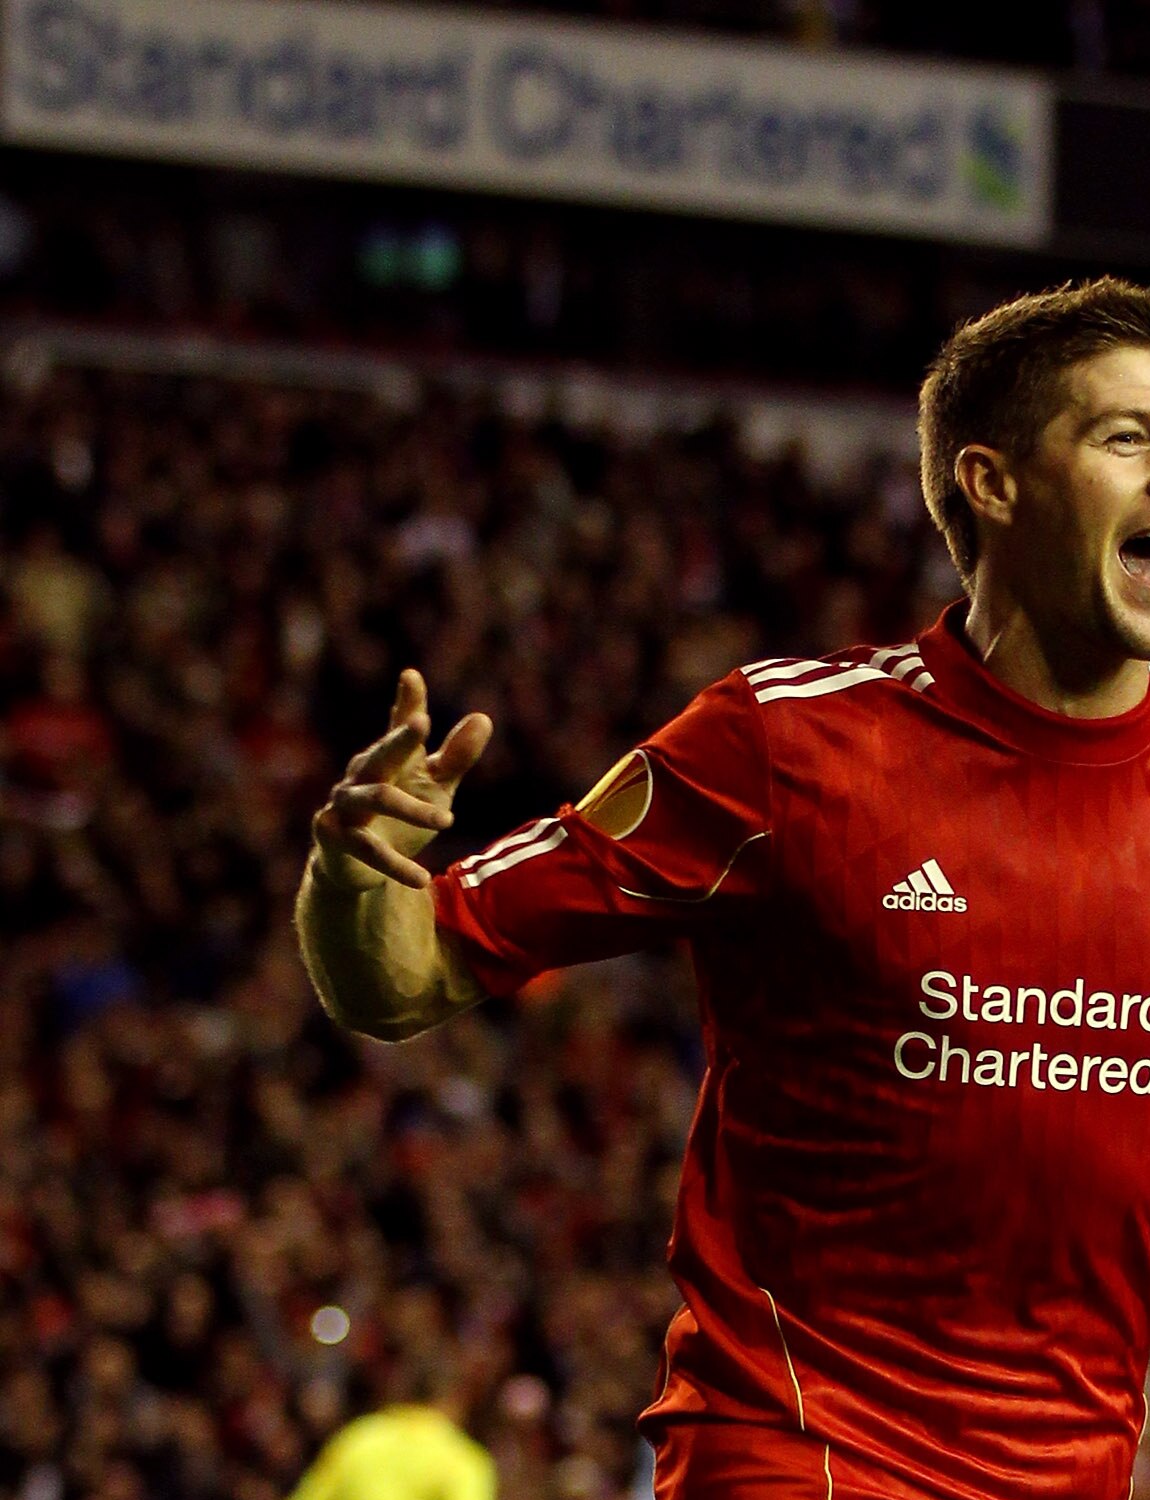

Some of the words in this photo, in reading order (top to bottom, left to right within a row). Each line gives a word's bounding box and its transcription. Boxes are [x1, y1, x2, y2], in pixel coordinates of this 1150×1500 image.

[22, 0, 470, 152] Standard
[484, 40, 947, 201] Chartered
[882, 891, 968, 913] adidas
